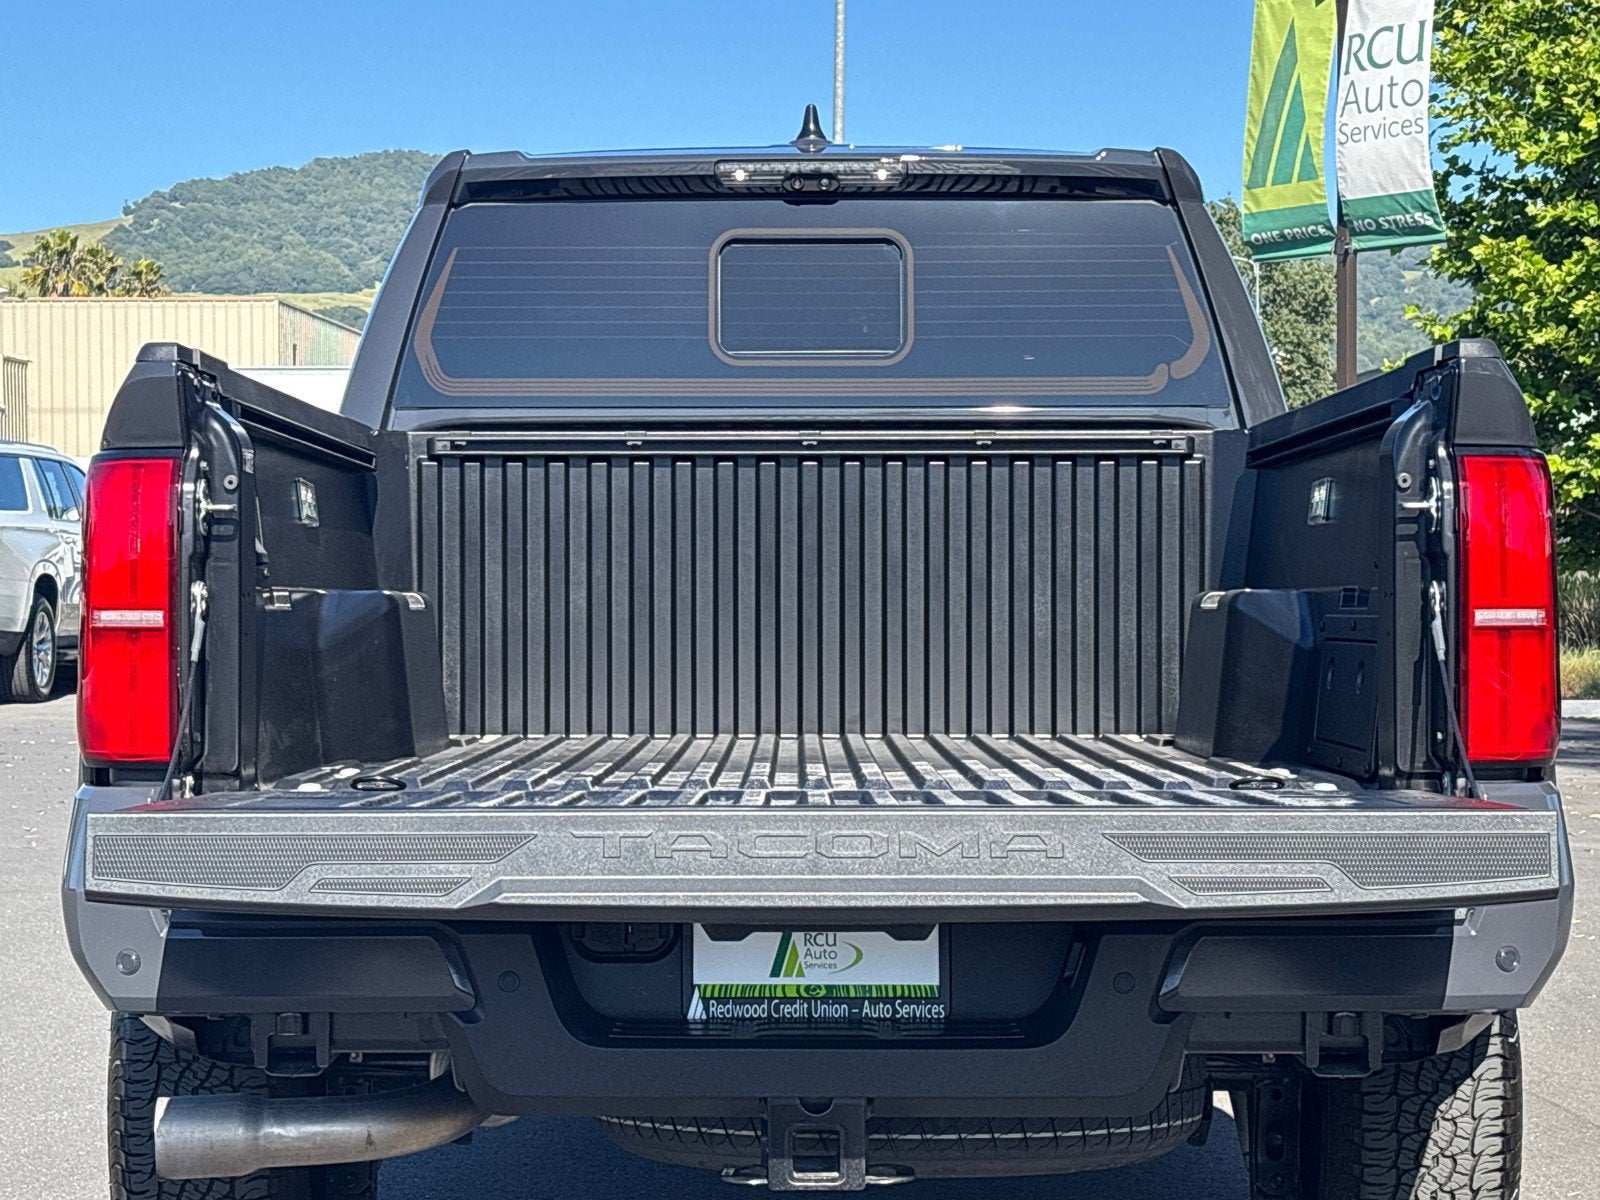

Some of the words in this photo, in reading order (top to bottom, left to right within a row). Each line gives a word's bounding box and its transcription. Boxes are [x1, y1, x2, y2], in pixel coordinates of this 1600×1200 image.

[1344, 20, 1428, 76] RCU
[1340, 76, 1424, 118] Auto
[1338, 116, 1425, 146] Services
[1352, 218, 1378, 232] NO
[1380, 212, 1434, 229] STRESS
[1250, 231, 1282, 246] ONE
[1285, 225, 1327, 241] PRICE
[571, 829, 1064, 859] TACOMA
[803, 932, 837, 947] RCU
[803, 947, 838, 960] Auto
[803, 960, 838, 970] Services
[709, 999, 768, 1018] Redwood
[770, 999, 809, 1018] Credit
[811, 1000, 849, 1018] Union
[861, 1000, 893, 1018] Auto
[895, 999, 946, 1018] Services
